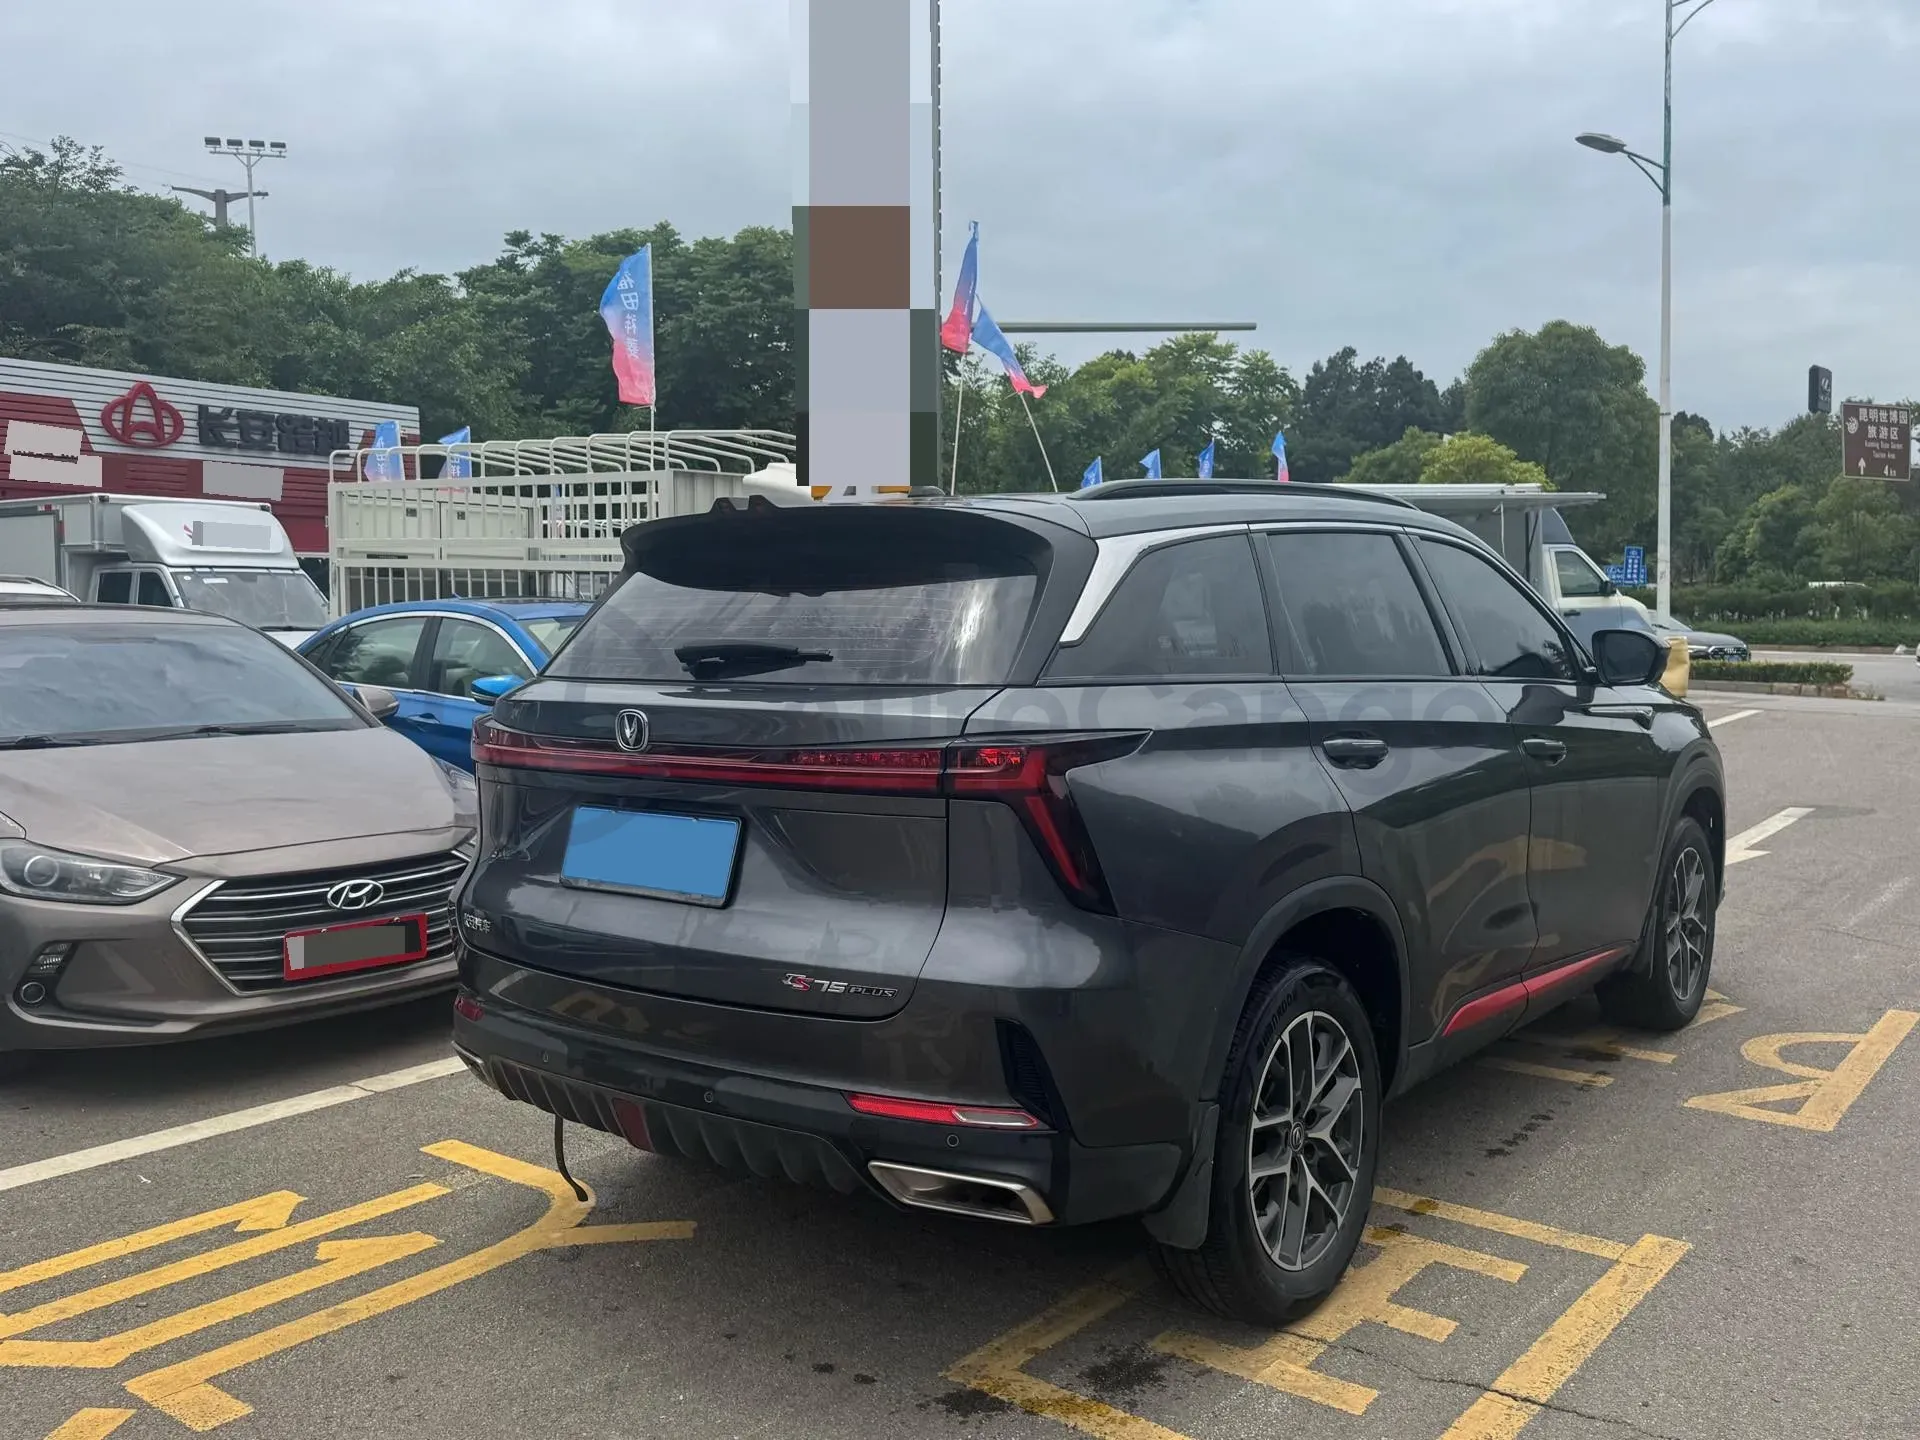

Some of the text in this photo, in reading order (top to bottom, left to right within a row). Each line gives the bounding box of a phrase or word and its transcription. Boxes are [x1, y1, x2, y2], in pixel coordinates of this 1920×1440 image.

[1867, 425, 1899, 440] 旅游区
[848, 985, 896, 998] PLUS
